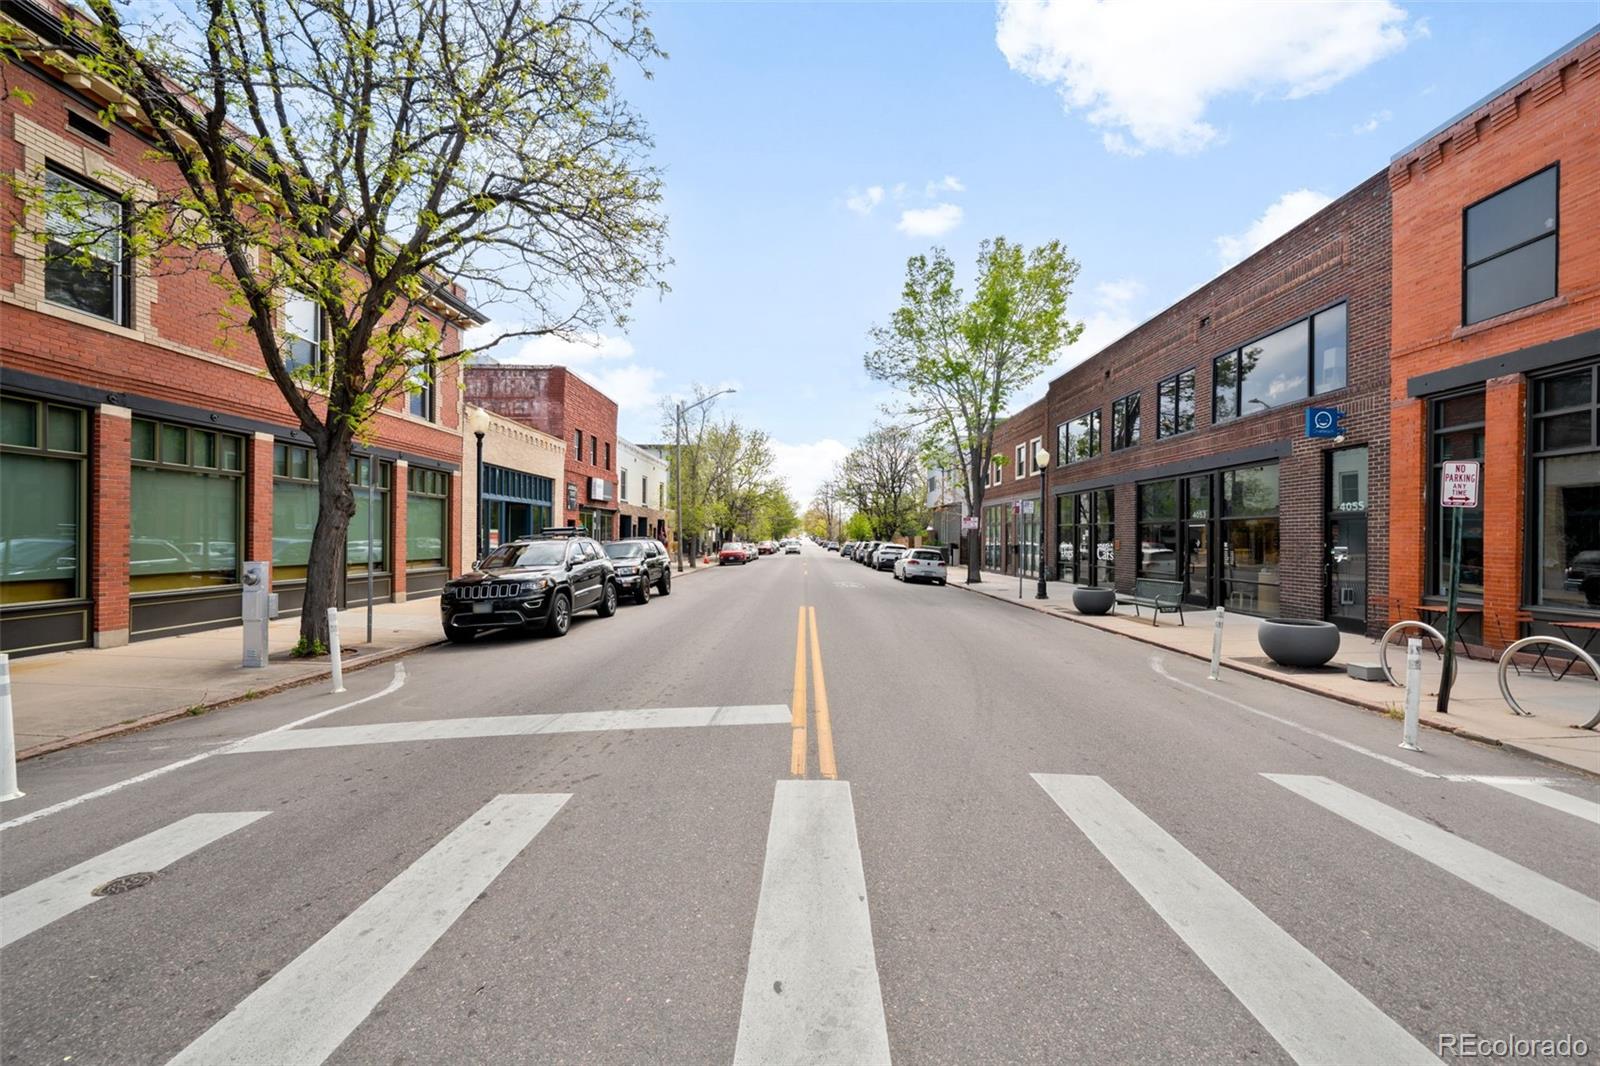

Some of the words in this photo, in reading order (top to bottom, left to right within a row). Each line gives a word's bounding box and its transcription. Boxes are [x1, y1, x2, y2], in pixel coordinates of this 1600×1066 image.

[1455, 464, 1466, 473] NO
[1445, 473, 1476, 483] PARKING
[1339, 501, 1365, 512] 4055
